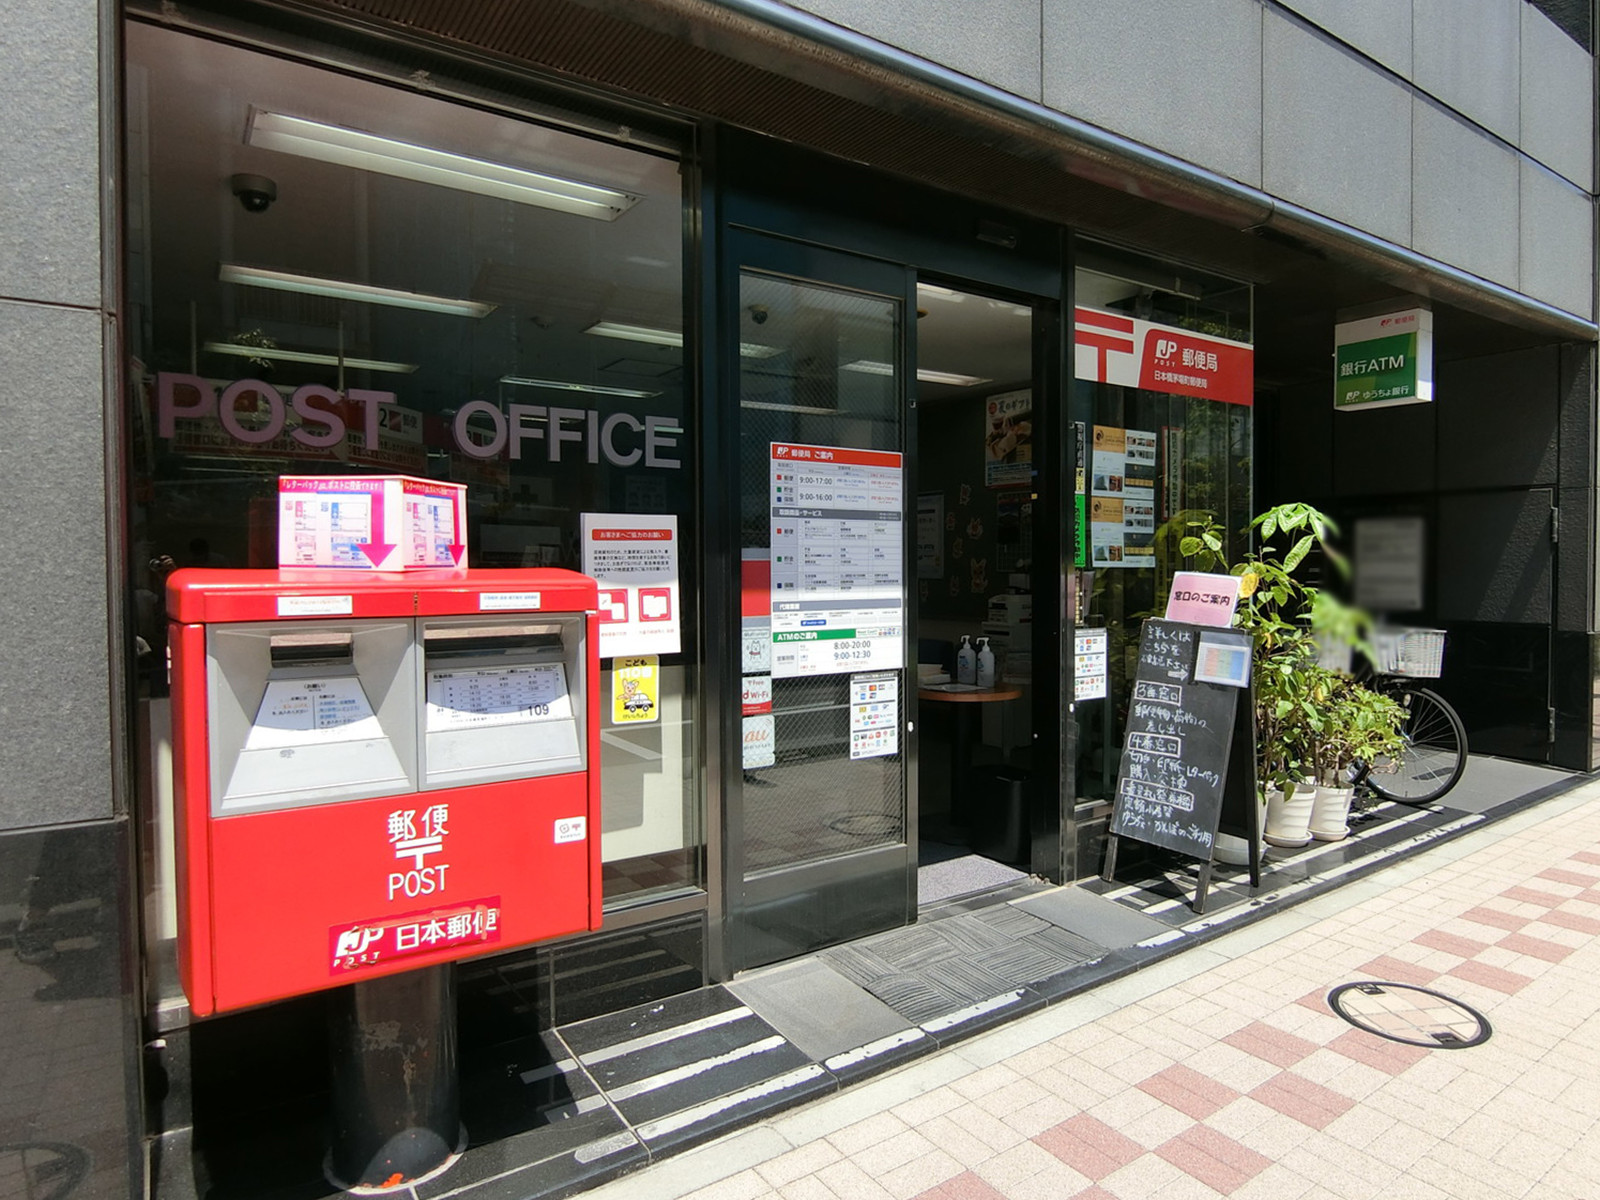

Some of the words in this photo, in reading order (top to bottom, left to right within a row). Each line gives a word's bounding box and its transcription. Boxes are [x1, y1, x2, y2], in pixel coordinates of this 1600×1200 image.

[1154, 359, 1176, 368] POST
[1182, 347, 1218, 373] 郵便局
[1340, 354, 1404, 377] 銀行ATM
[1363, 385, 1409, 400] ゆうちょ銀行
[158, 372, 397, 451] POST
[454, 400, 683, 470] OFFICE
[799, 476, 833, 485] 9:00-17:00
[799, 492, 833, 501] 9:00-16:00
[1174, 590, 1231, 607] 窓口のご案内
[1147, 625, 1191, 643] 詳しくは
[834, 640, 871, 650] 8:00-20:00
[1144, 642, 1181, 657] こちらを
[624, 658, 648, 667] こども
[833, 650, 871, 661] 9:00-12:30
[750, 691, 769, 699] Wi-Fi
[1137, 684, 1178, 702] 3番窓口
[528, 703, 550, 717] 109
[744, 730, 769, 742] au
[1145, 719, 1187, 738] 差し出し
[1131, 734, 1177, 752] 4番窓口
[387, 803, 450, 843] 郵便
[388, 864, 450, 901] POST
[396, 908, 498, 951] 日本郵便
[333, 951, 380, 967] POST
